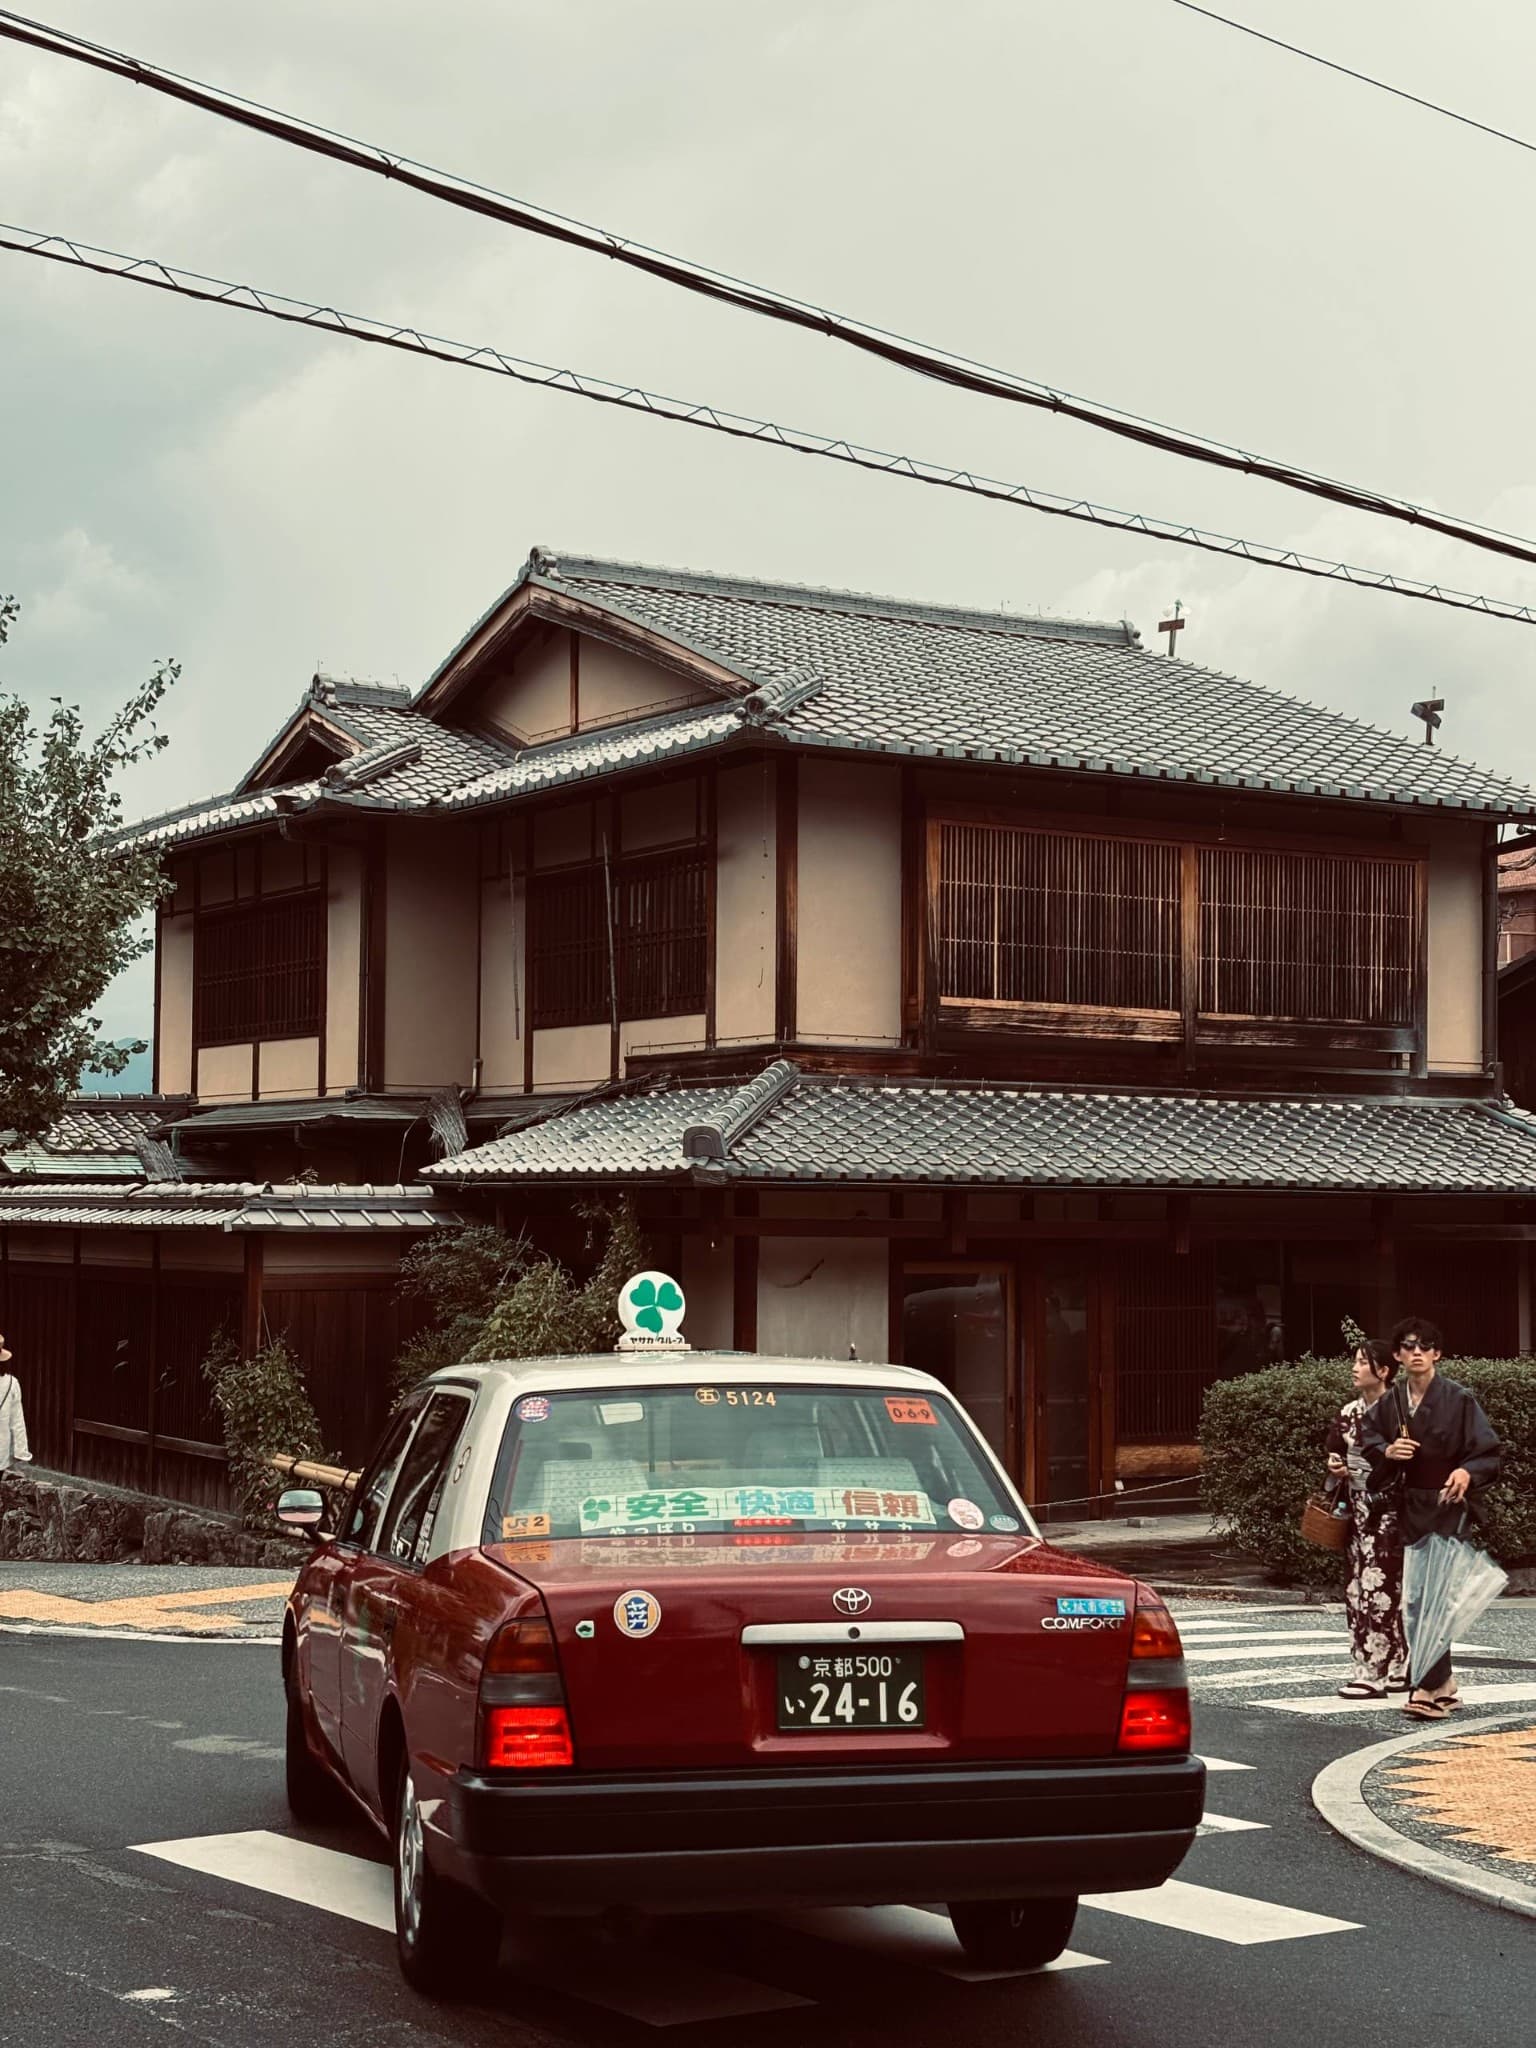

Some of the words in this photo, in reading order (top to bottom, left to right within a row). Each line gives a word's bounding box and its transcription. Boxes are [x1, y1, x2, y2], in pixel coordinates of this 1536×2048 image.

[726, 1391, 777, 1406] 5124
[507, 1517, 528, 1529] JR
[533, 1515, 545, 1528] 2
[1041, 1617, 1125, 1630] COMFORT
[784, 1696, 806, 1715] い
[810, 1681, 919, 1724] 24-16
